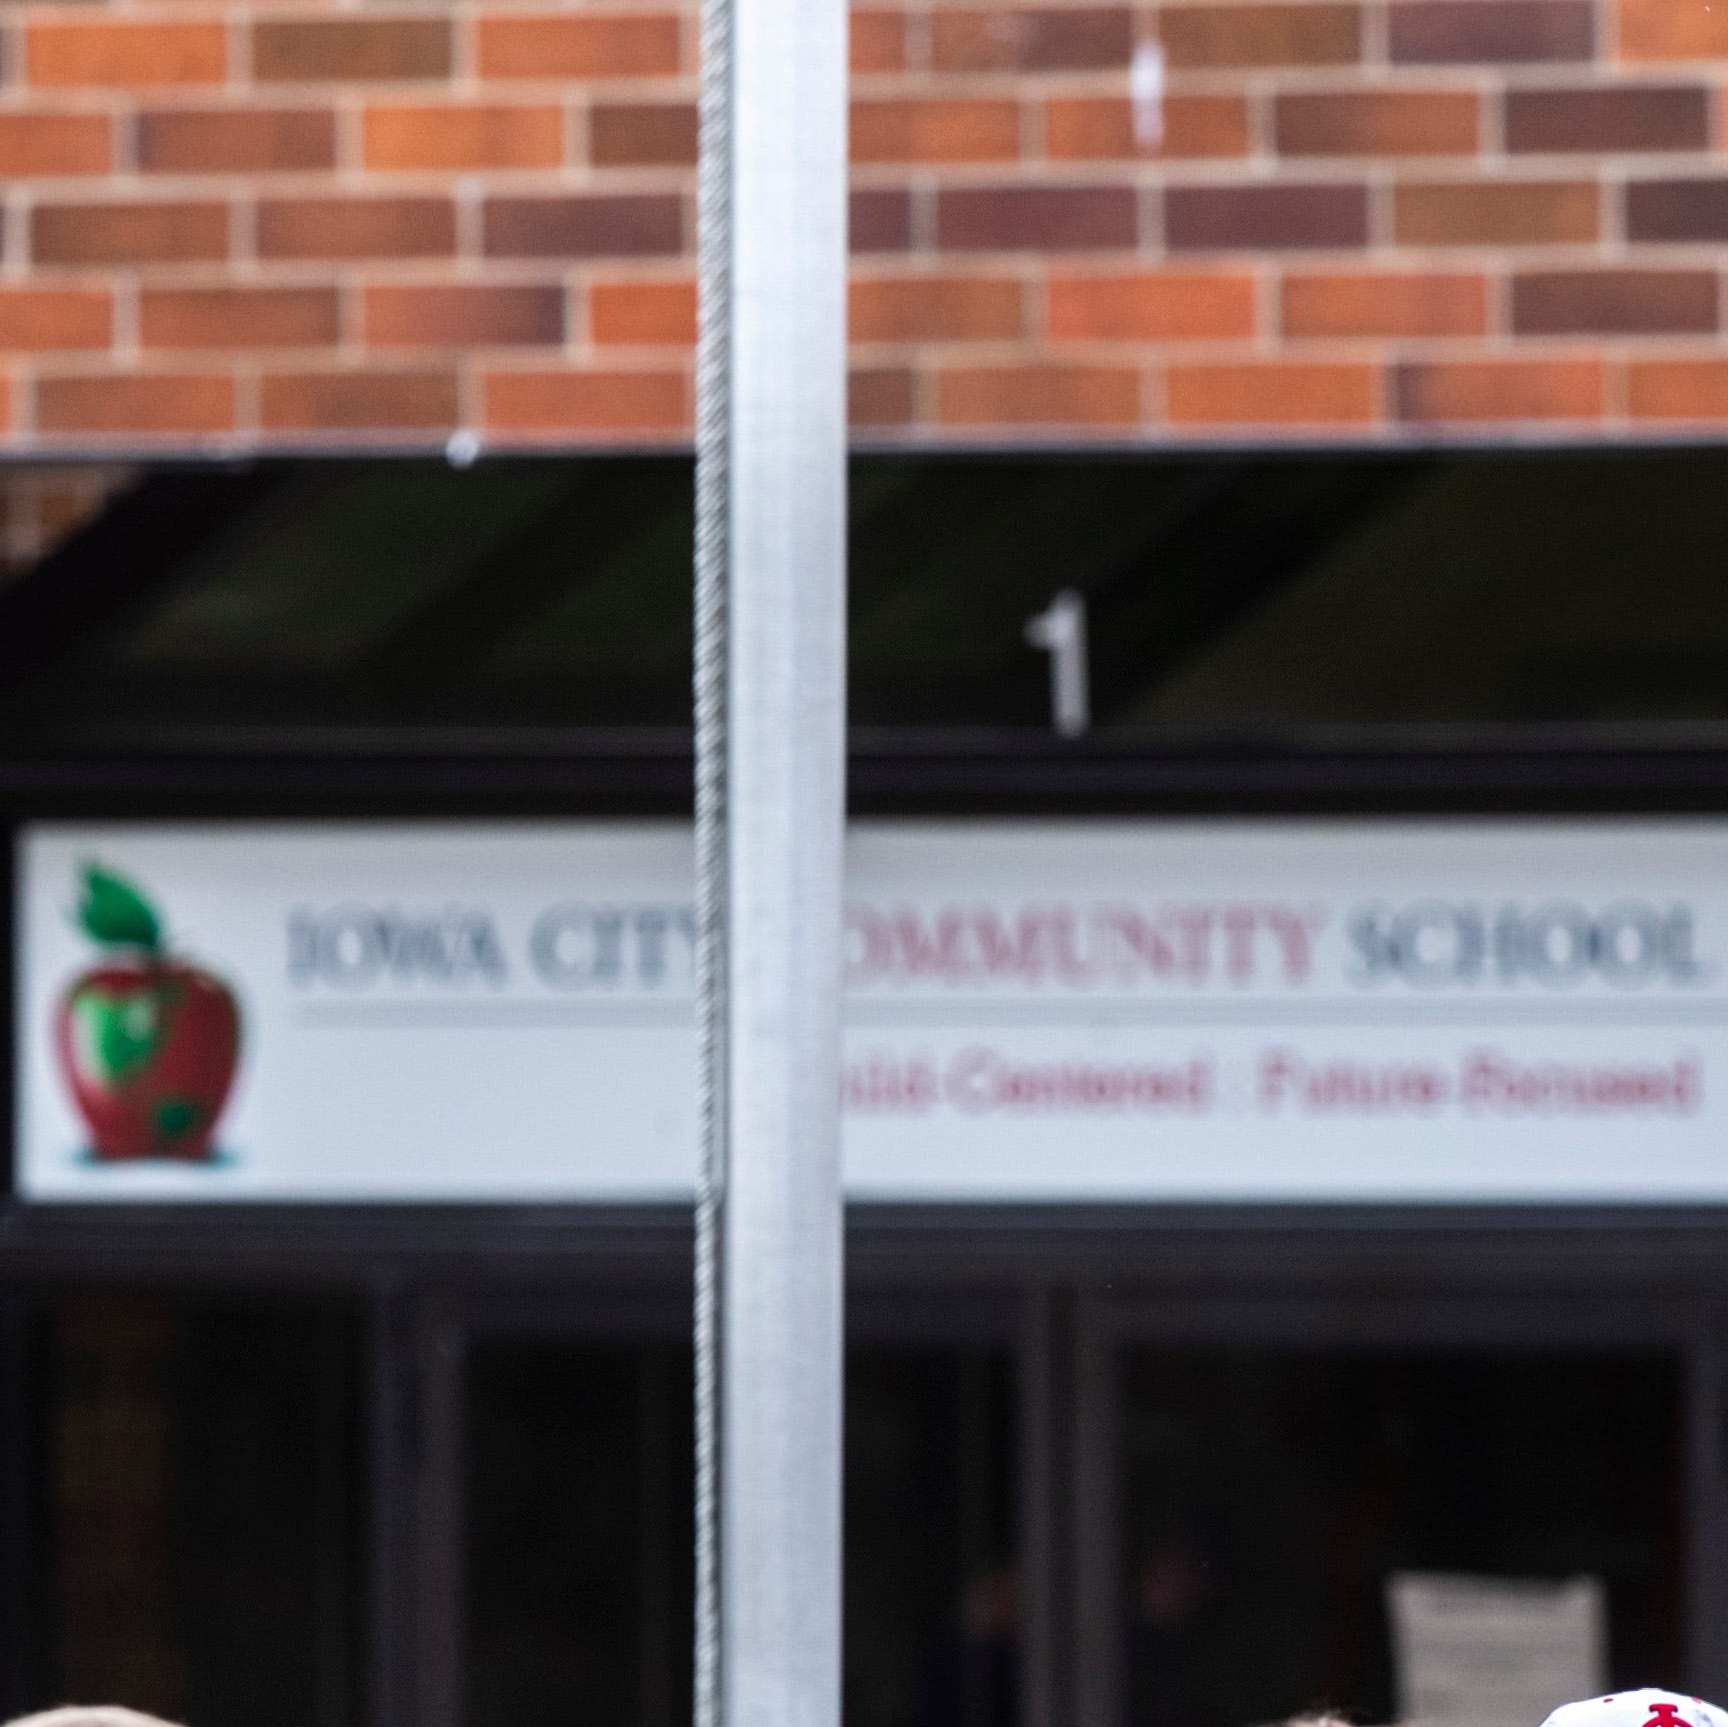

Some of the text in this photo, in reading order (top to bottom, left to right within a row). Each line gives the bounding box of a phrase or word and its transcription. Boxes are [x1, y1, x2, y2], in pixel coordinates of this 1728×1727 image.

[283, 900, 510, 990] IOWA
[842, 900, 1330, 992] OMMUNITY
[1345, 898, 1714, 993] SCHOOL
